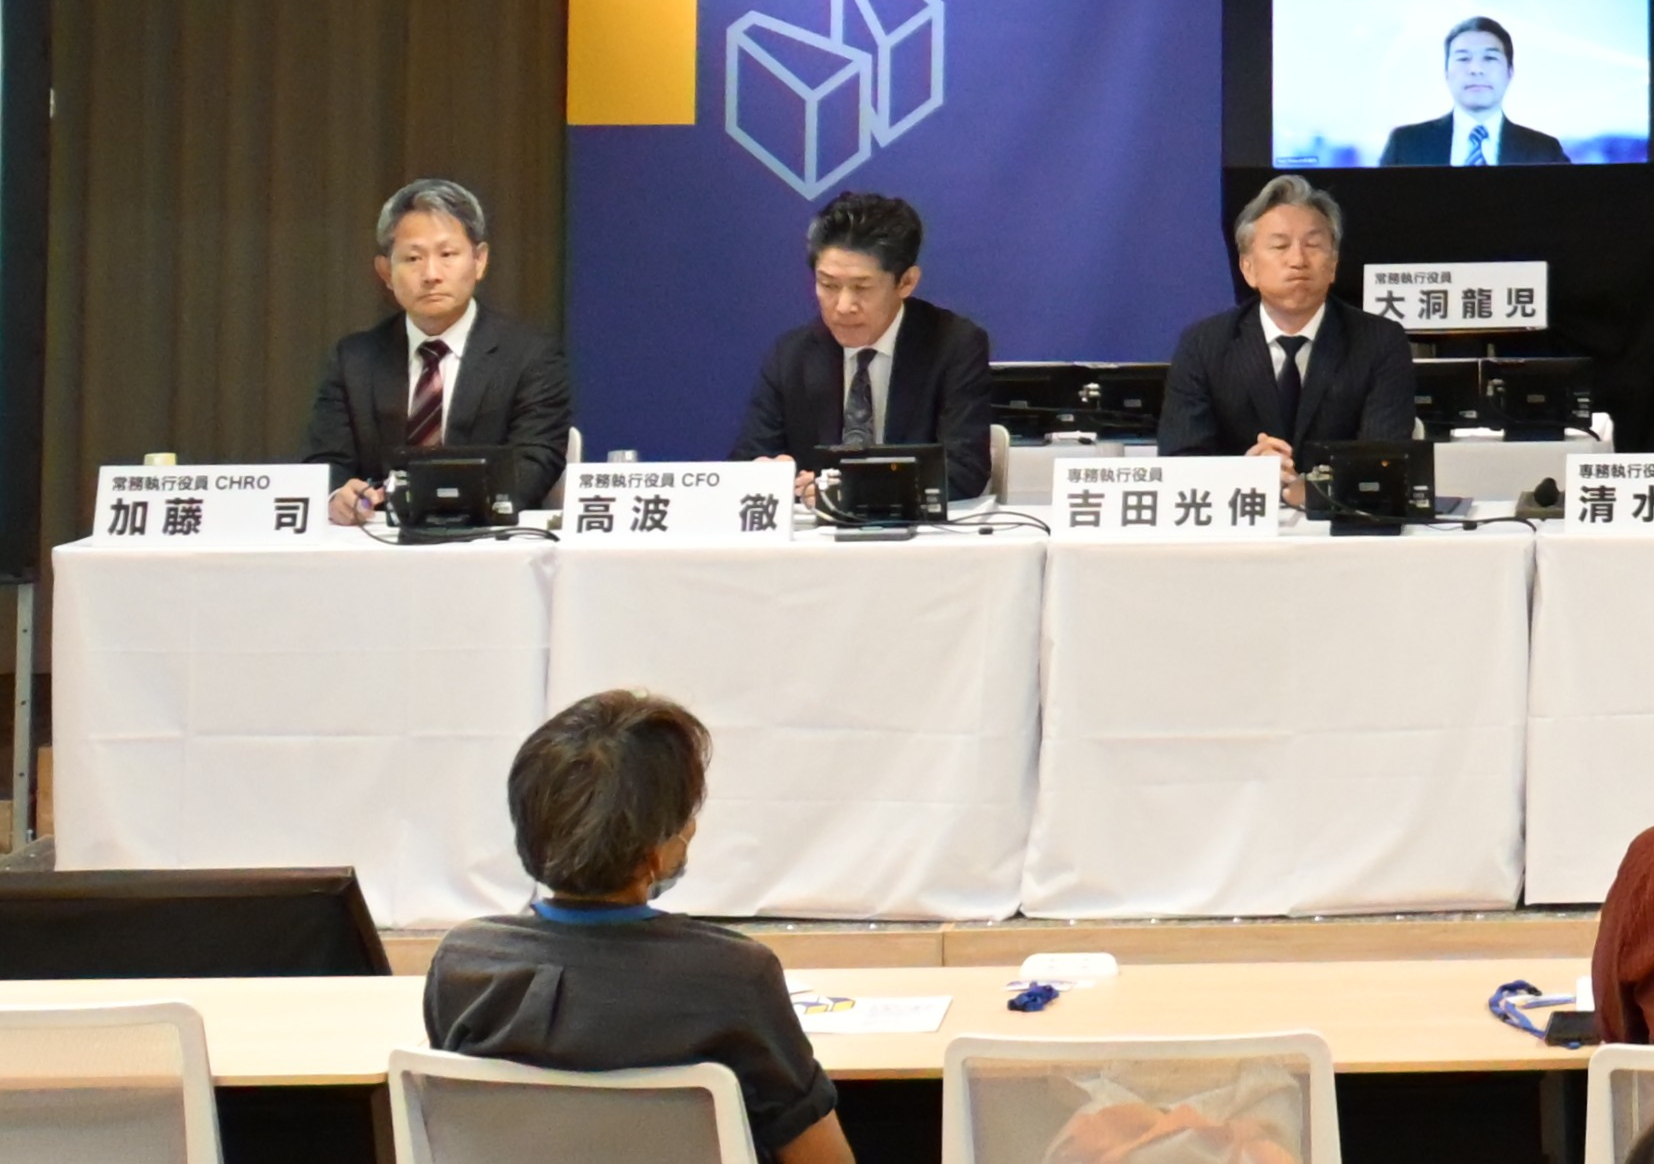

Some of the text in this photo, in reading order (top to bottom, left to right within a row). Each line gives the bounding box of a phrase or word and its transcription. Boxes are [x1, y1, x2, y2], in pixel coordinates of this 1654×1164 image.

[1375, 271, 1452, 285] 常務執行役員
[1375, 287, 1536, 320] 大洞龍児
[112, 475, 270, 491] 常務執行役員 CHRO
[579, 473, 720, 489] 常務執行役員 CFO
[1067, 467, 1163, 484] 専務執行役員
[1067, 487, 1266, 528] 吉田光伸
